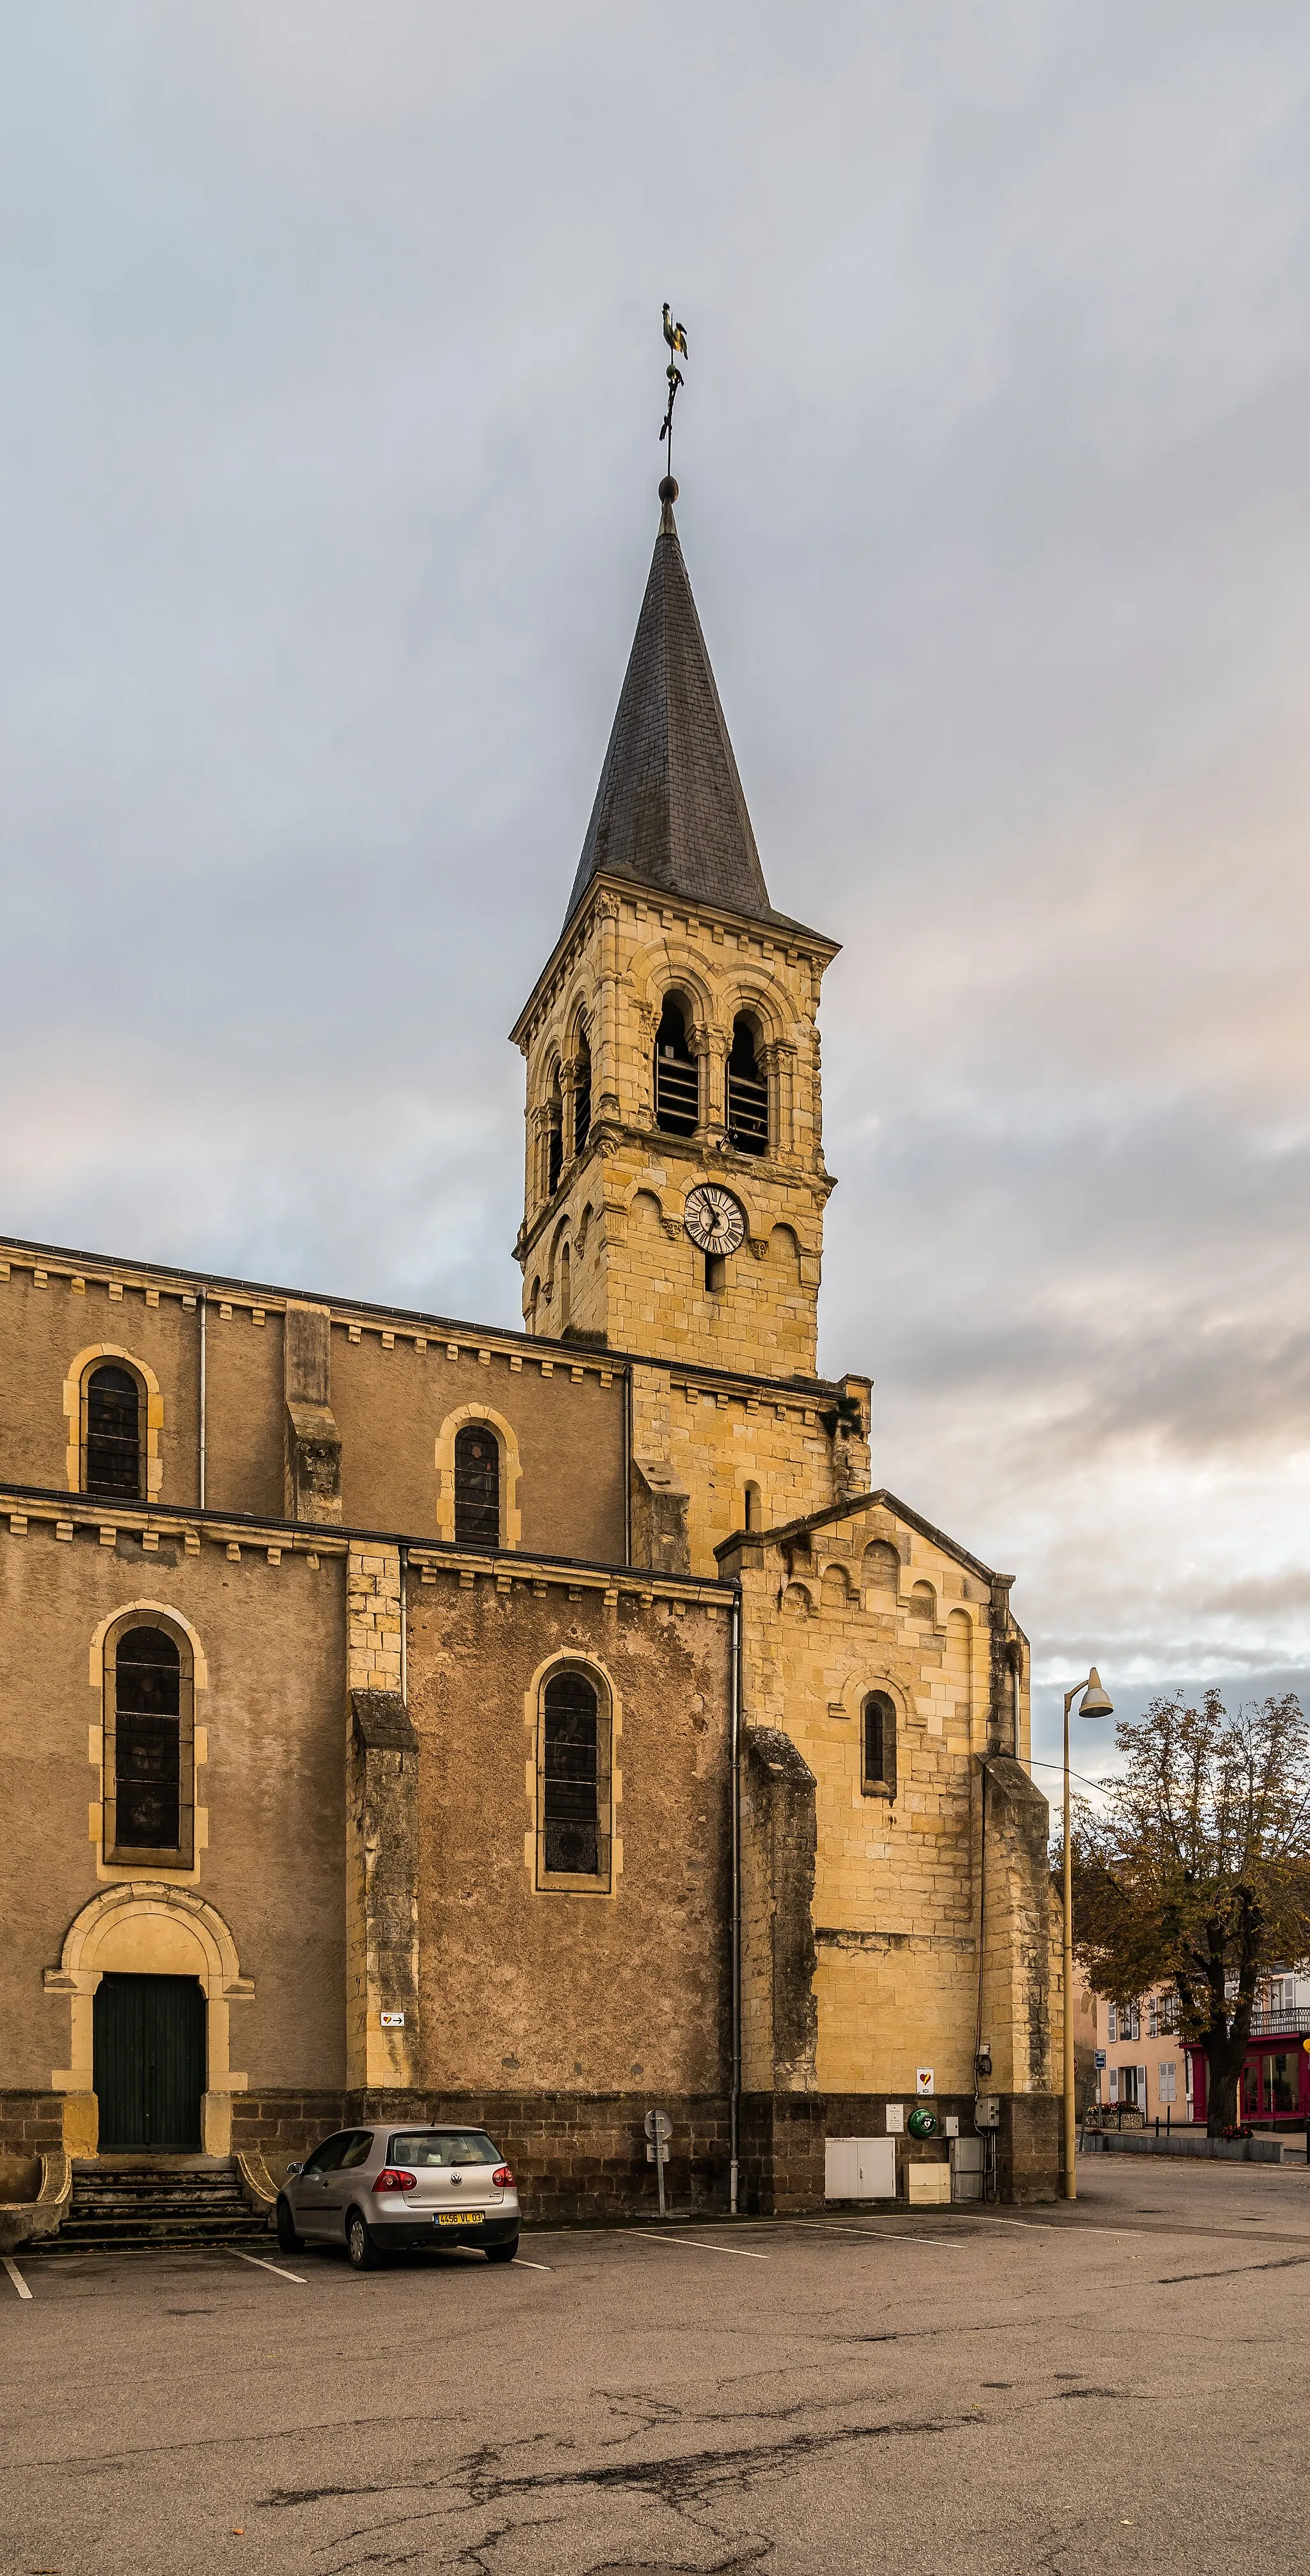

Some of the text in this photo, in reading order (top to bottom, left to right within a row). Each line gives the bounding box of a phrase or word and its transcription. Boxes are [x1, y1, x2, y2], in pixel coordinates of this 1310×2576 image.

[441, 2213, 481, 2223] 4456 VL 03
